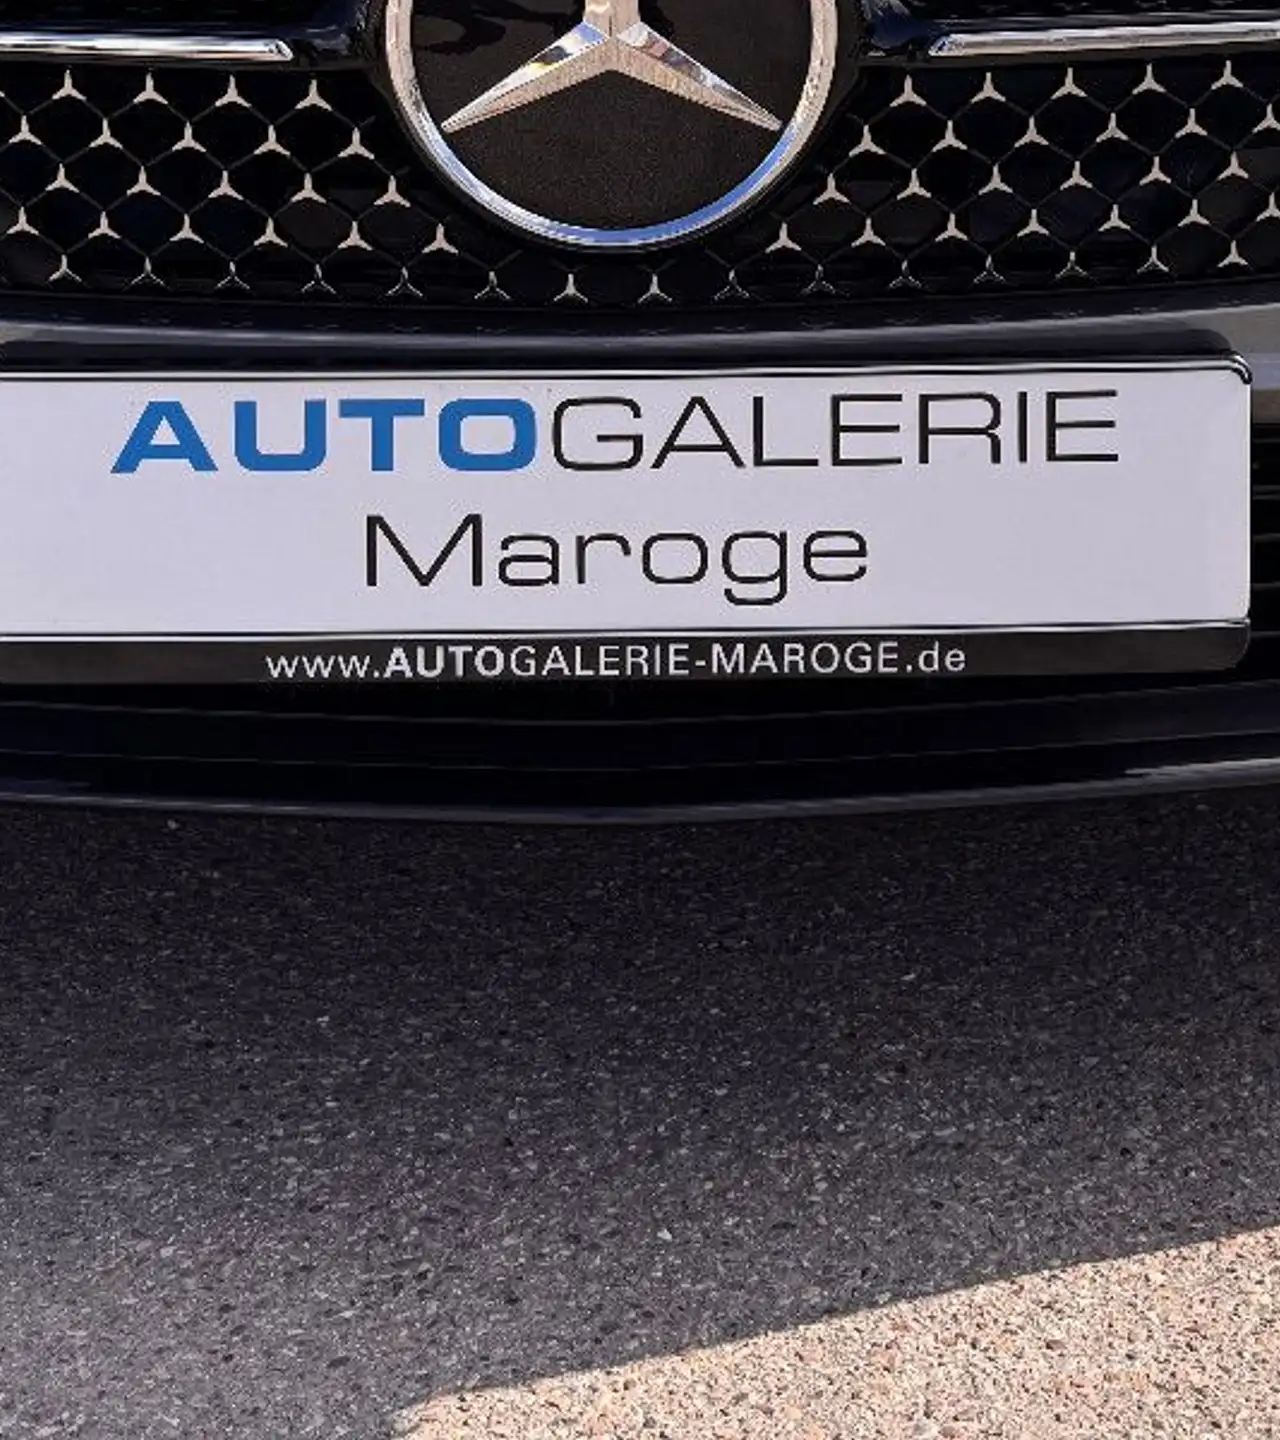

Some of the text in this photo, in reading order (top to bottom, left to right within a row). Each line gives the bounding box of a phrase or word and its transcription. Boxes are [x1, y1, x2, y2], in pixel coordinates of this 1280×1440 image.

[111, 389, 1118, 473] AUTOGALERIE
[367, 514, 867, 605] Maroge
[266, 642, 964, 677] www.AUTOGALERIE-MAROGE.de
